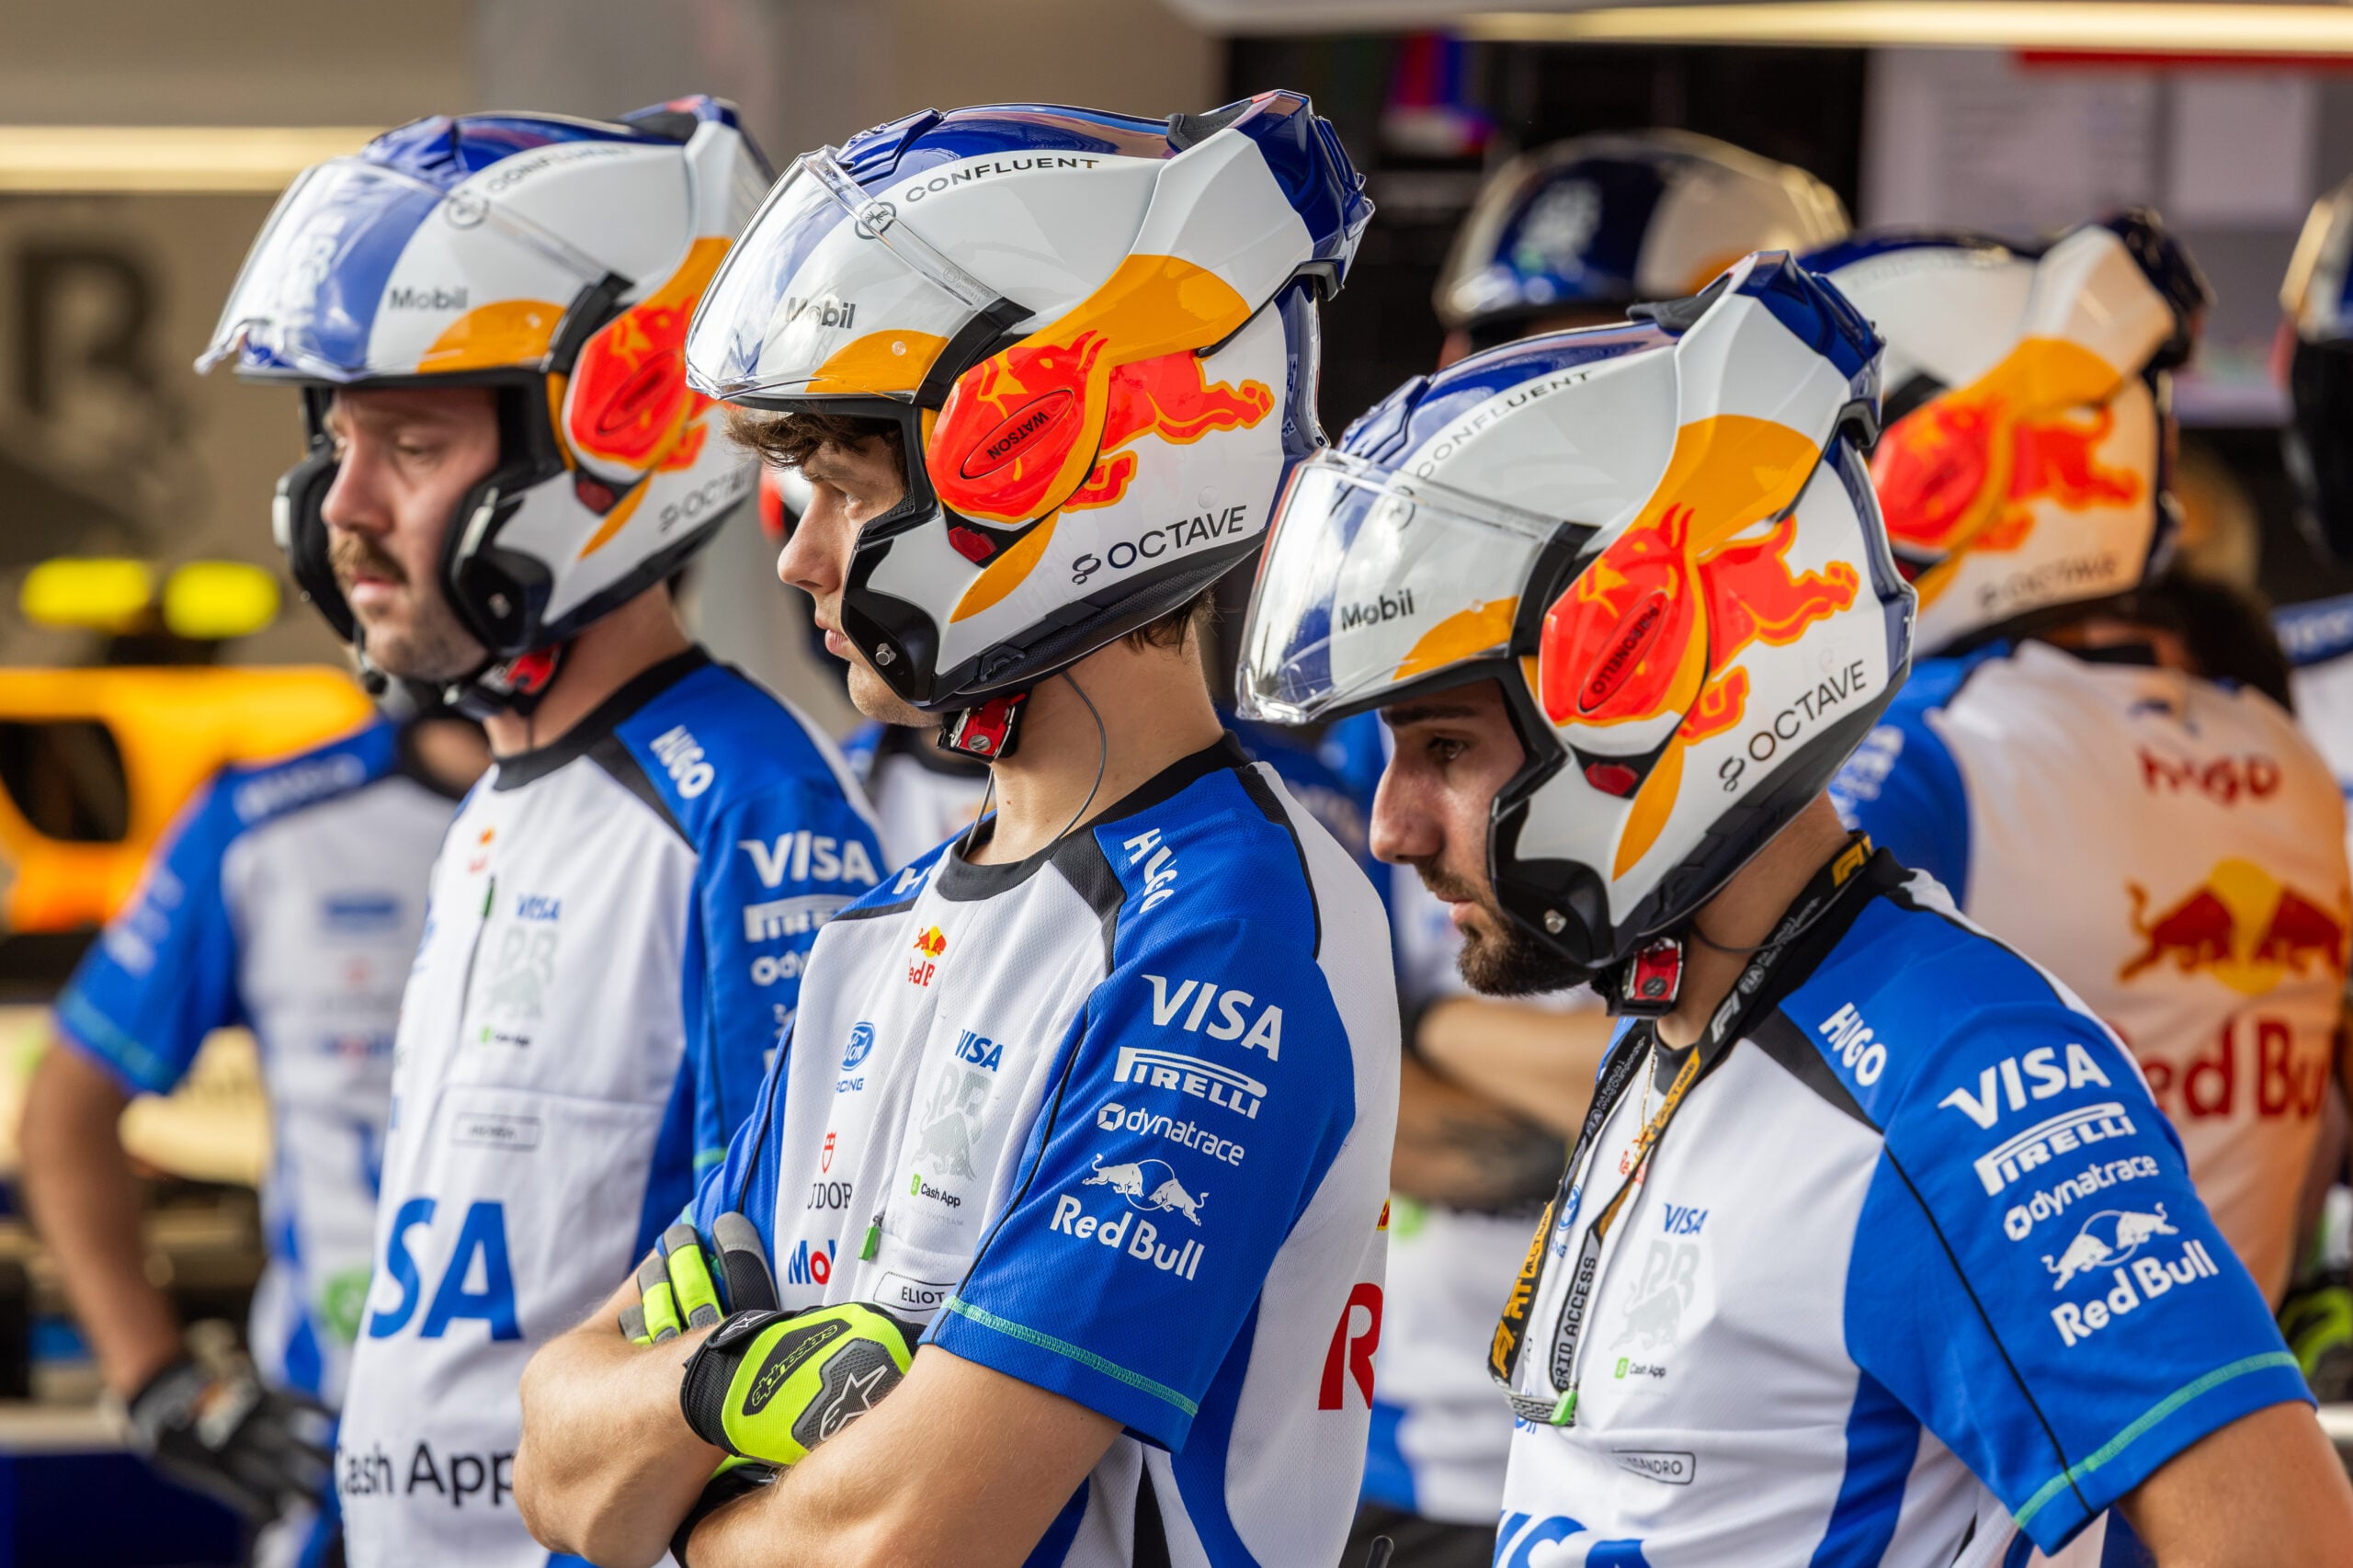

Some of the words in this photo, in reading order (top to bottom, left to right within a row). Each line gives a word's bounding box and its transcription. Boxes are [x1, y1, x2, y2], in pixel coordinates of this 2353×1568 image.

[905, 157, 1099, 202] CONFLUENT
[390, 287, 469, 310] Mobil
[786, 296, 857, 329] Mobil
[986, 409, 1050, 460] WATSON
[1416, 370, 1593, 478] CONFLUENT
[1108, 506, 1247, 569] OCTAVE
[1341, 588, 1415, 631] Mobil
[1748, 660, 1867, 761] OCTAVE
[649, 724, 715, 800] HUGO
[738, 831, 880, 888] VISA
[1123, 827, 1178, 915] HUGO
[1142, 974, 1283, 1062] VISA
[1818, 1002, 1887, 1086] HUGO
[955, 1028, 1005, 1073] VISA
[1113, 1046, 1267, 1119] PIRELLI
[1937, 1044, 2111, 1130] VISA
[1126, 1108, 1245, 1166] dynatrace
[1973, 1102, 2136, 1196] PIRELLI
[921, 1183, 940, 1200] Cash
[940, 1192, 961, 1209] App
[1664, 1201, 1709, 1234] VISA
[2030, 1155, 2159, 1222] dynatrace
[1050, 1194, 1132, 1248] Red
[1128, 1220, 1205, 1281] Bull
[901, 1286, 945, 1304] ELIOT
[1504, 1278, 1532, 1320] PIT
[1564, 1256, 1597, 1337] ACCESS
[2051, 1267, 2140, 1346] Red
[2131, 1239, 2219, 1299] Bull
[1555, 1343, 1574, 1391] GRID
